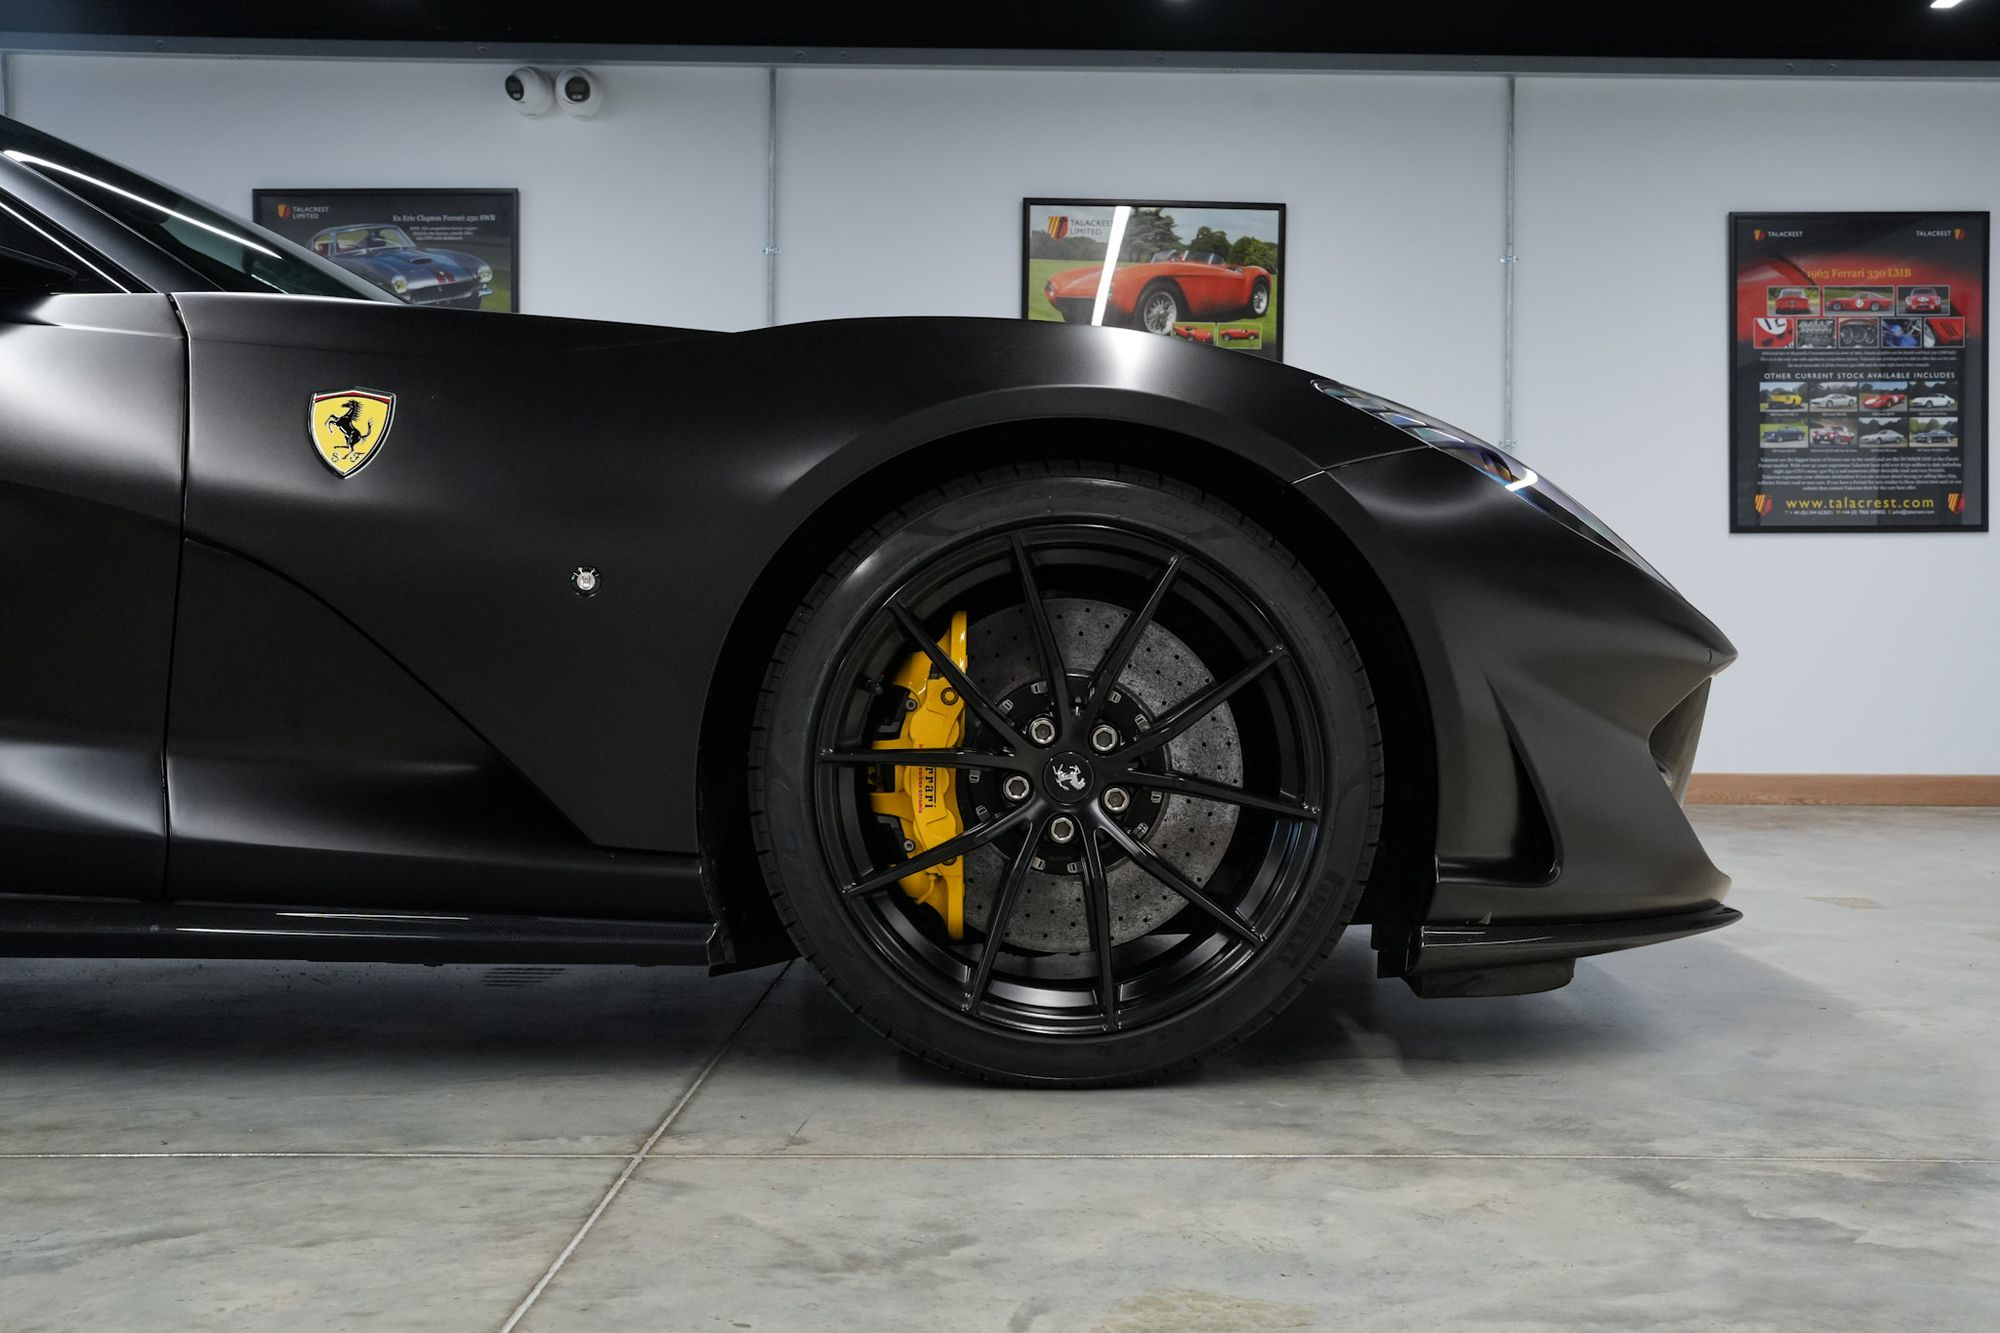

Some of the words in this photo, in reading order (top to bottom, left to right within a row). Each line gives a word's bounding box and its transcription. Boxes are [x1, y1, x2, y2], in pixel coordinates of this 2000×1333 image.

[1832, 268, 1865, 278] Ferrari
[1867, 270, 1886, 280] 330
[1888, 268, 1912, 278] LMB
[1913, 371, 1956, 379] INCLUDES
[1786, 497, 1934, 509] www.talacrest.com
[925, 766, 936, 808] rrari
